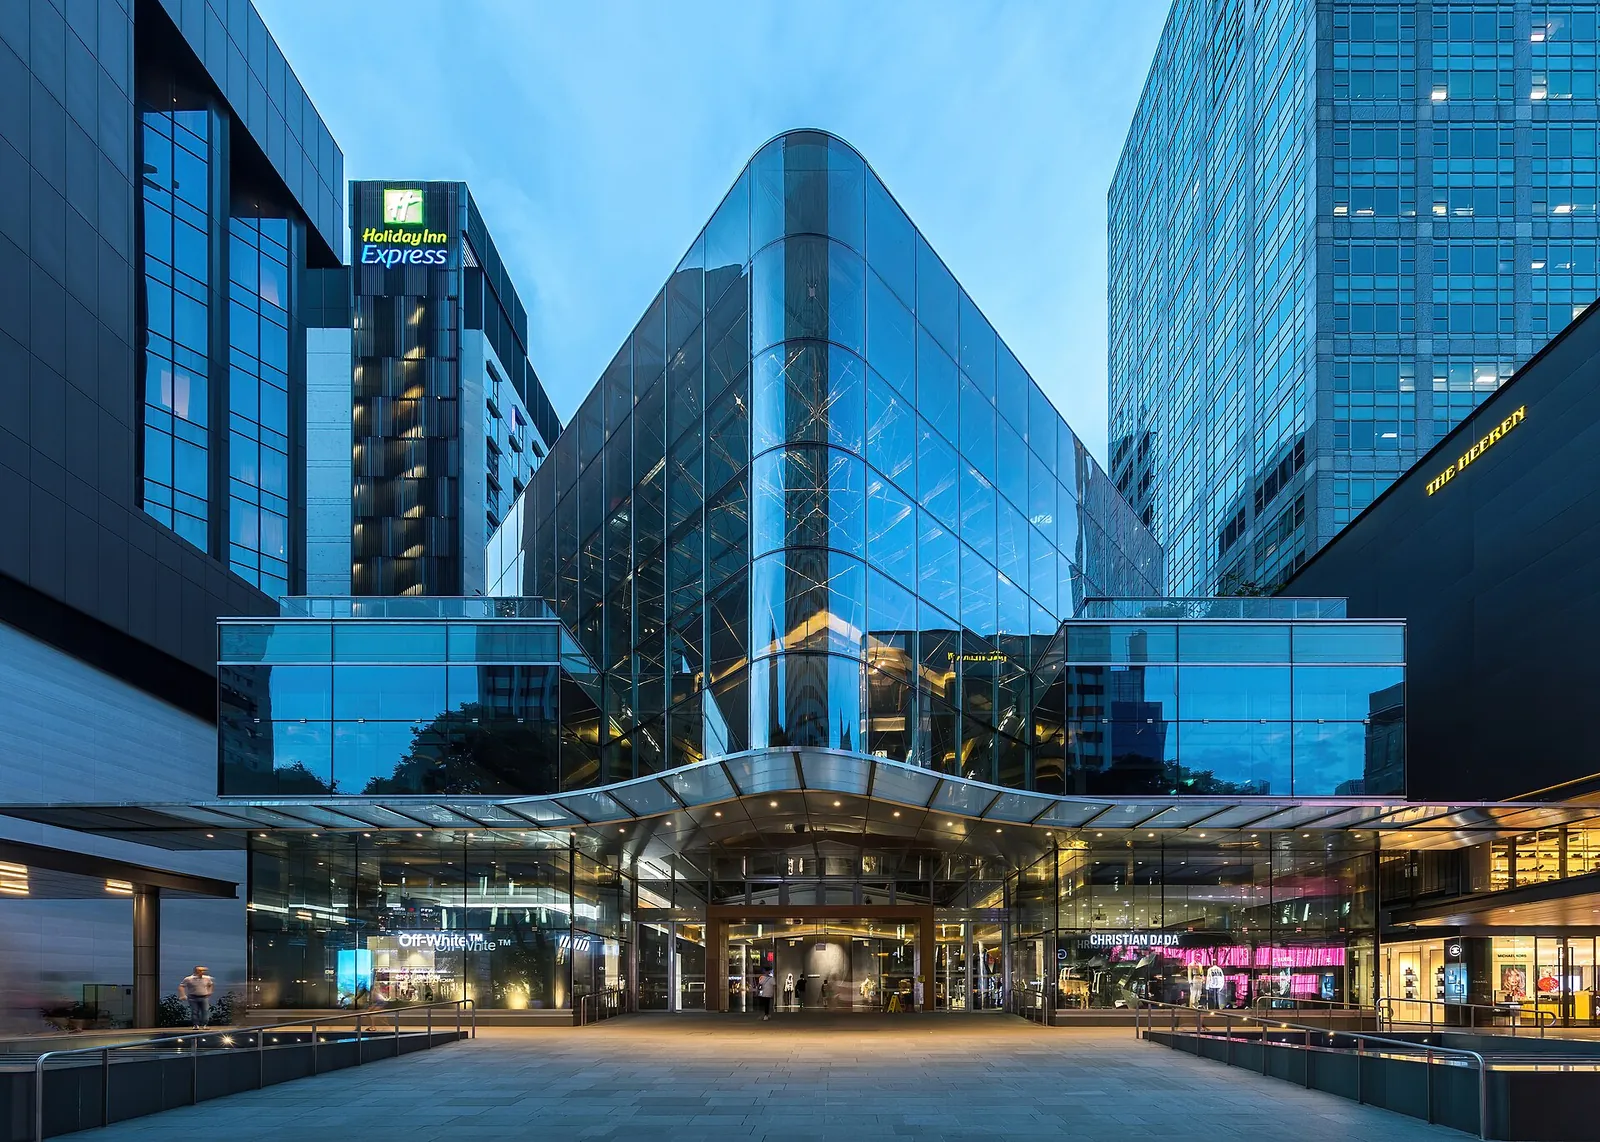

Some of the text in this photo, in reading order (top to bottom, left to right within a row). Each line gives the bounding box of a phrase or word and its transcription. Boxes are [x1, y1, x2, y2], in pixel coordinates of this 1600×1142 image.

[362, 228, 447, 246] Holiday Inn
[361, 245, 447, 269] Express
[1426, 405, 1526, 495] THE HEEREN
[399, 933, 465, 947] Off-White
[1090, 934, 1147, 946] CHRISTIAN
[1149, 934, 1179, 946] DADA
